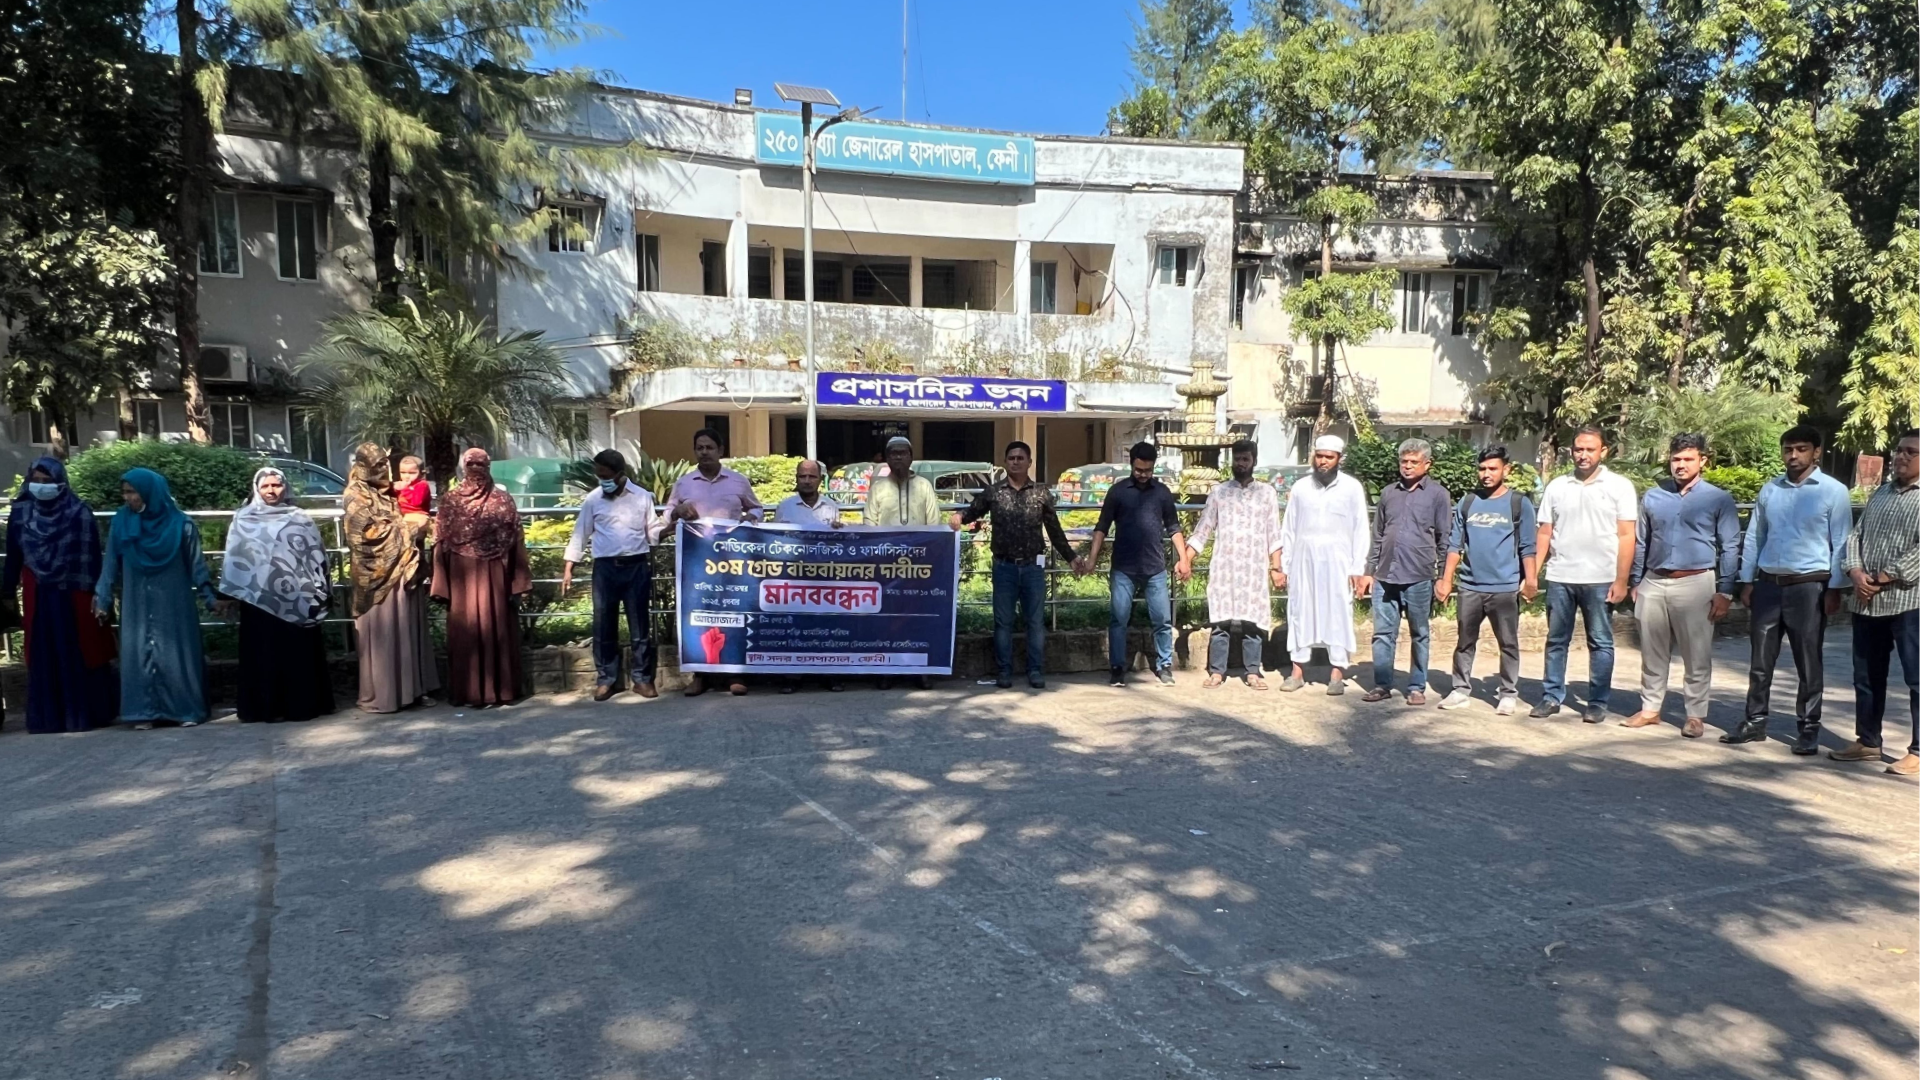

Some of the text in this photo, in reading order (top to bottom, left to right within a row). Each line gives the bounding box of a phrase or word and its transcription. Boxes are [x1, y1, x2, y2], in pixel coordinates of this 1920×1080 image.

[763, 128, 799, 155] ২৫০
[842, 135, 904, 163] জেনারেল
[907, 140, 981, 175] হাসপাতাল,
[831, 377, 1052, 402] প্রশাসনিক ভবন
[858, 397, 880, 406] ২৫০
[882, 398, 904, 407] শয্যা
[906, 399, 946, 408] জেনারেল
[713, 538, 927, 557] মেডিকেল টেকনোলজিস্ট ও ফার্মাসিস্টদের
[705, 556, 933, 580] ১০ম গ্রেড বাস্তবায়নের দাবীতে
[763, 582, 880, 610] মানববন্ধন
